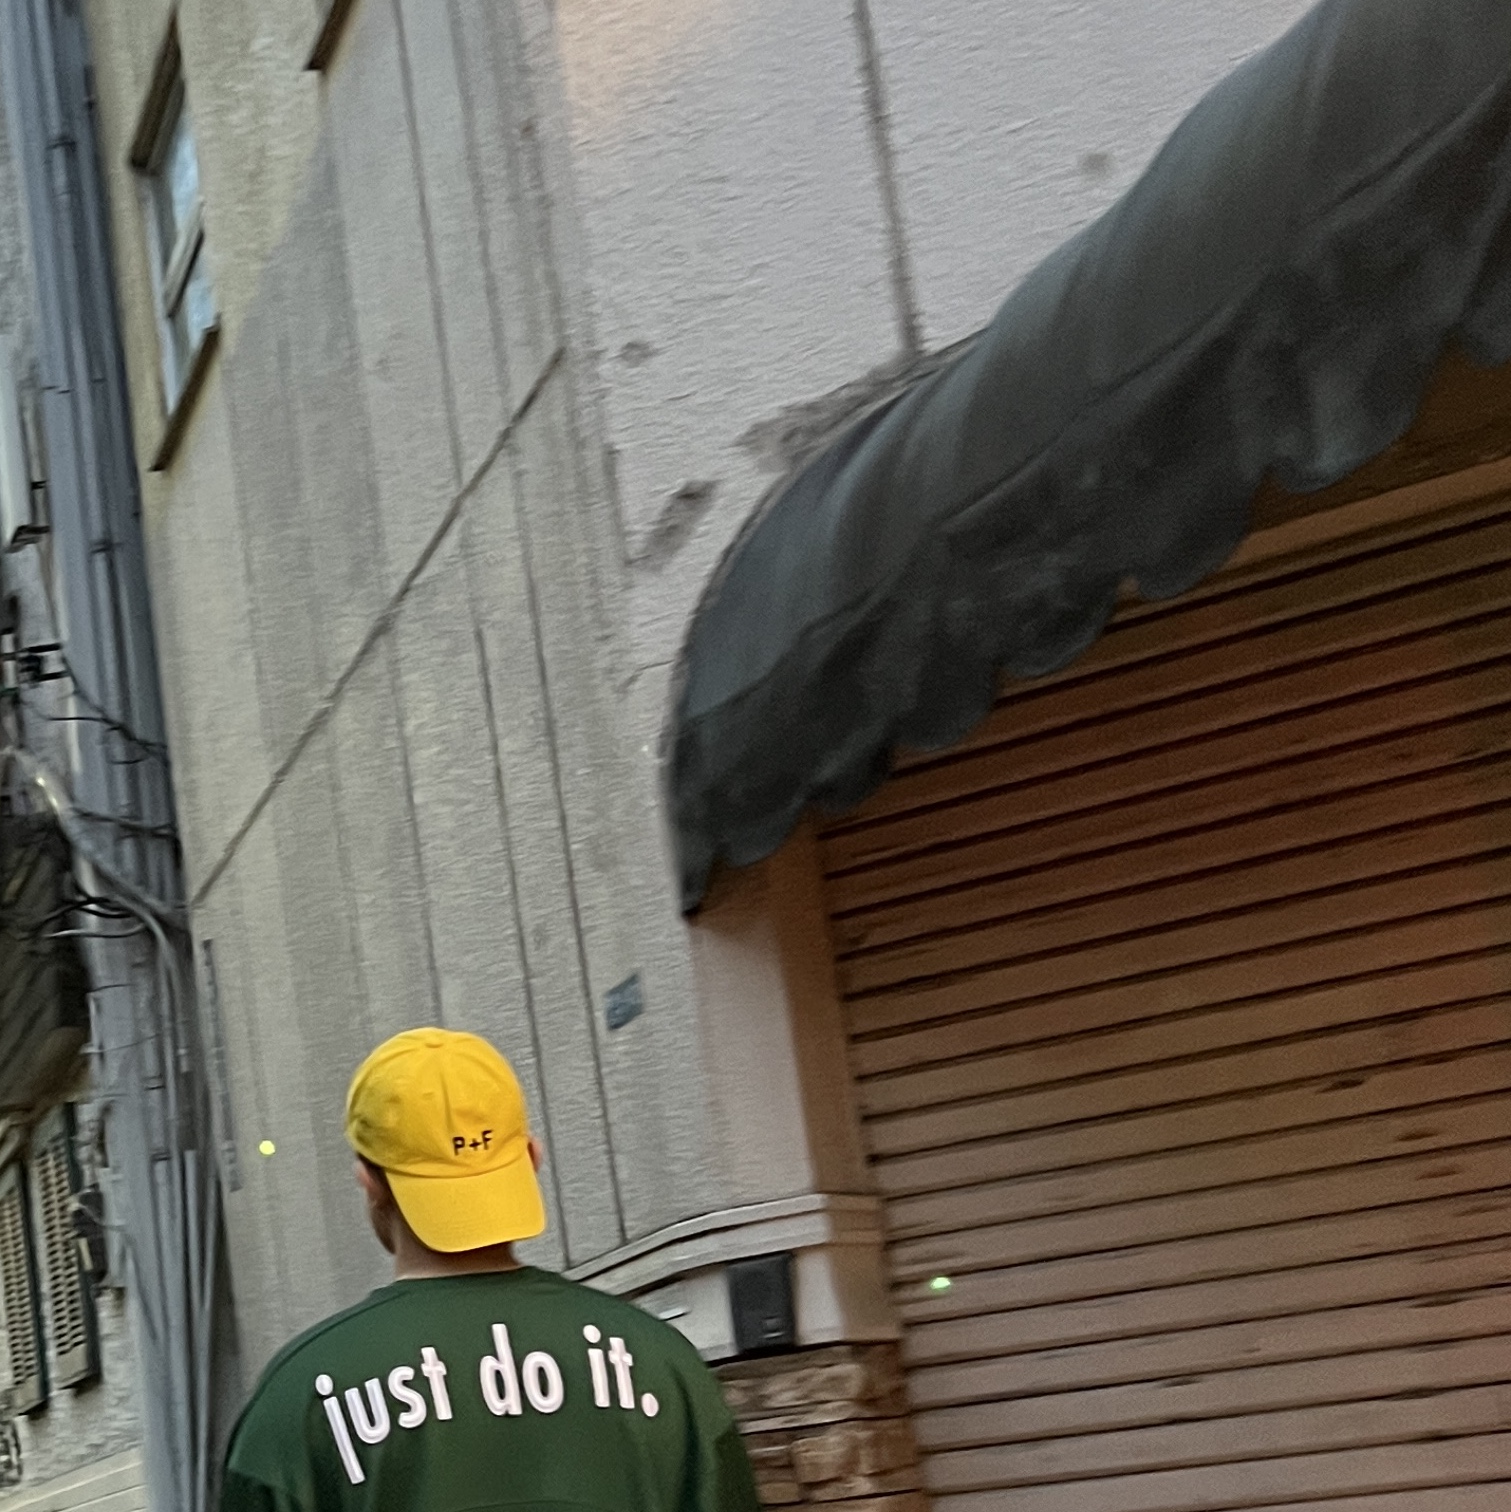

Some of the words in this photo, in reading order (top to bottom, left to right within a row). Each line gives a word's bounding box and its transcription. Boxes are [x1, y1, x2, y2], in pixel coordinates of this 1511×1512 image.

[452, 1129, 494, 1157] P+F
[315, 1346, 453, 1485] just
[479, 1323, 564, 1416] do
[582, 1324, 660, 1417] it.
